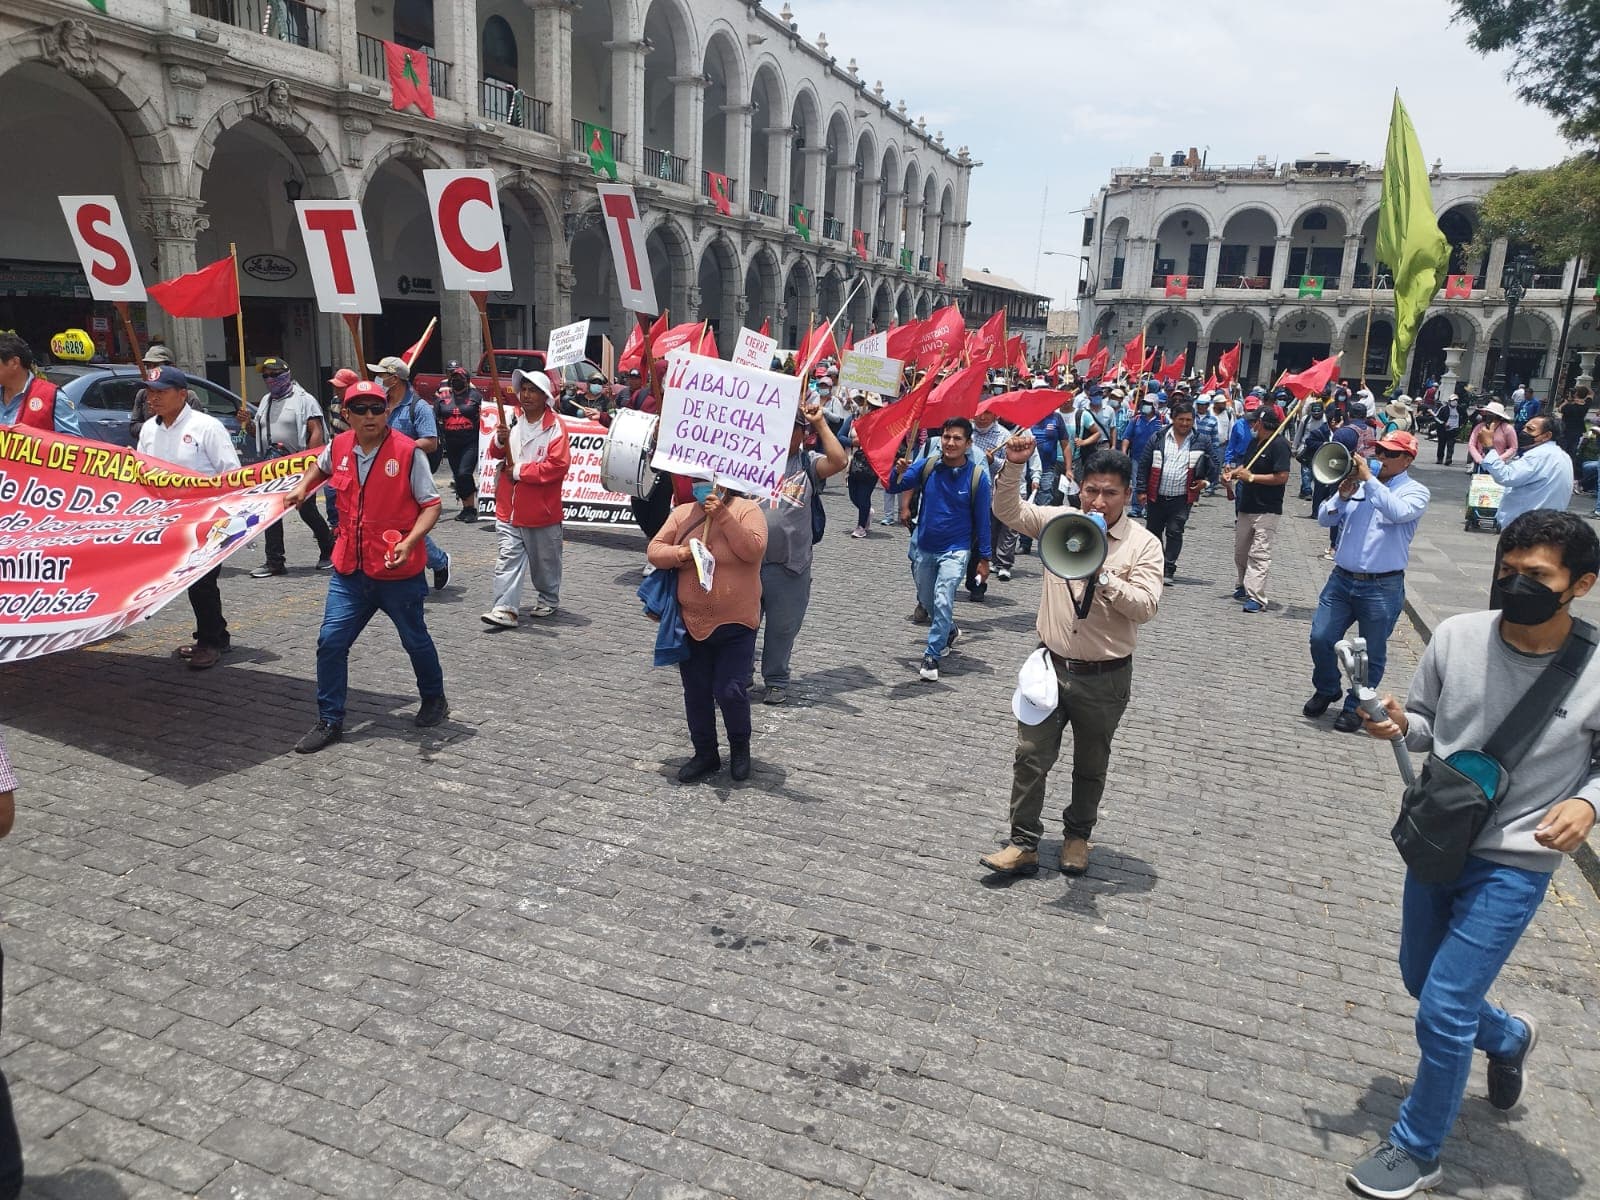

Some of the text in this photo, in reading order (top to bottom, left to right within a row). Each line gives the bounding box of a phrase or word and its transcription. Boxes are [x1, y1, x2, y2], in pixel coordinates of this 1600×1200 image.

[76, 203, 131, 286] S
[439, 177, 502, 272] C
[604, 194, 645, 291] T
[305, 209, 356, 294] T
[682, 397, 765, 435] DERECHA
[756, 383, 781, 409] LA
[47, 441, 79, 472] DE
[676, 419, 786, 465] GOLPISTA Y
[22, 478, 64, 508] los
[69, 487, 120, 514] D.S.
[578, 505, 610, 521] Digno
